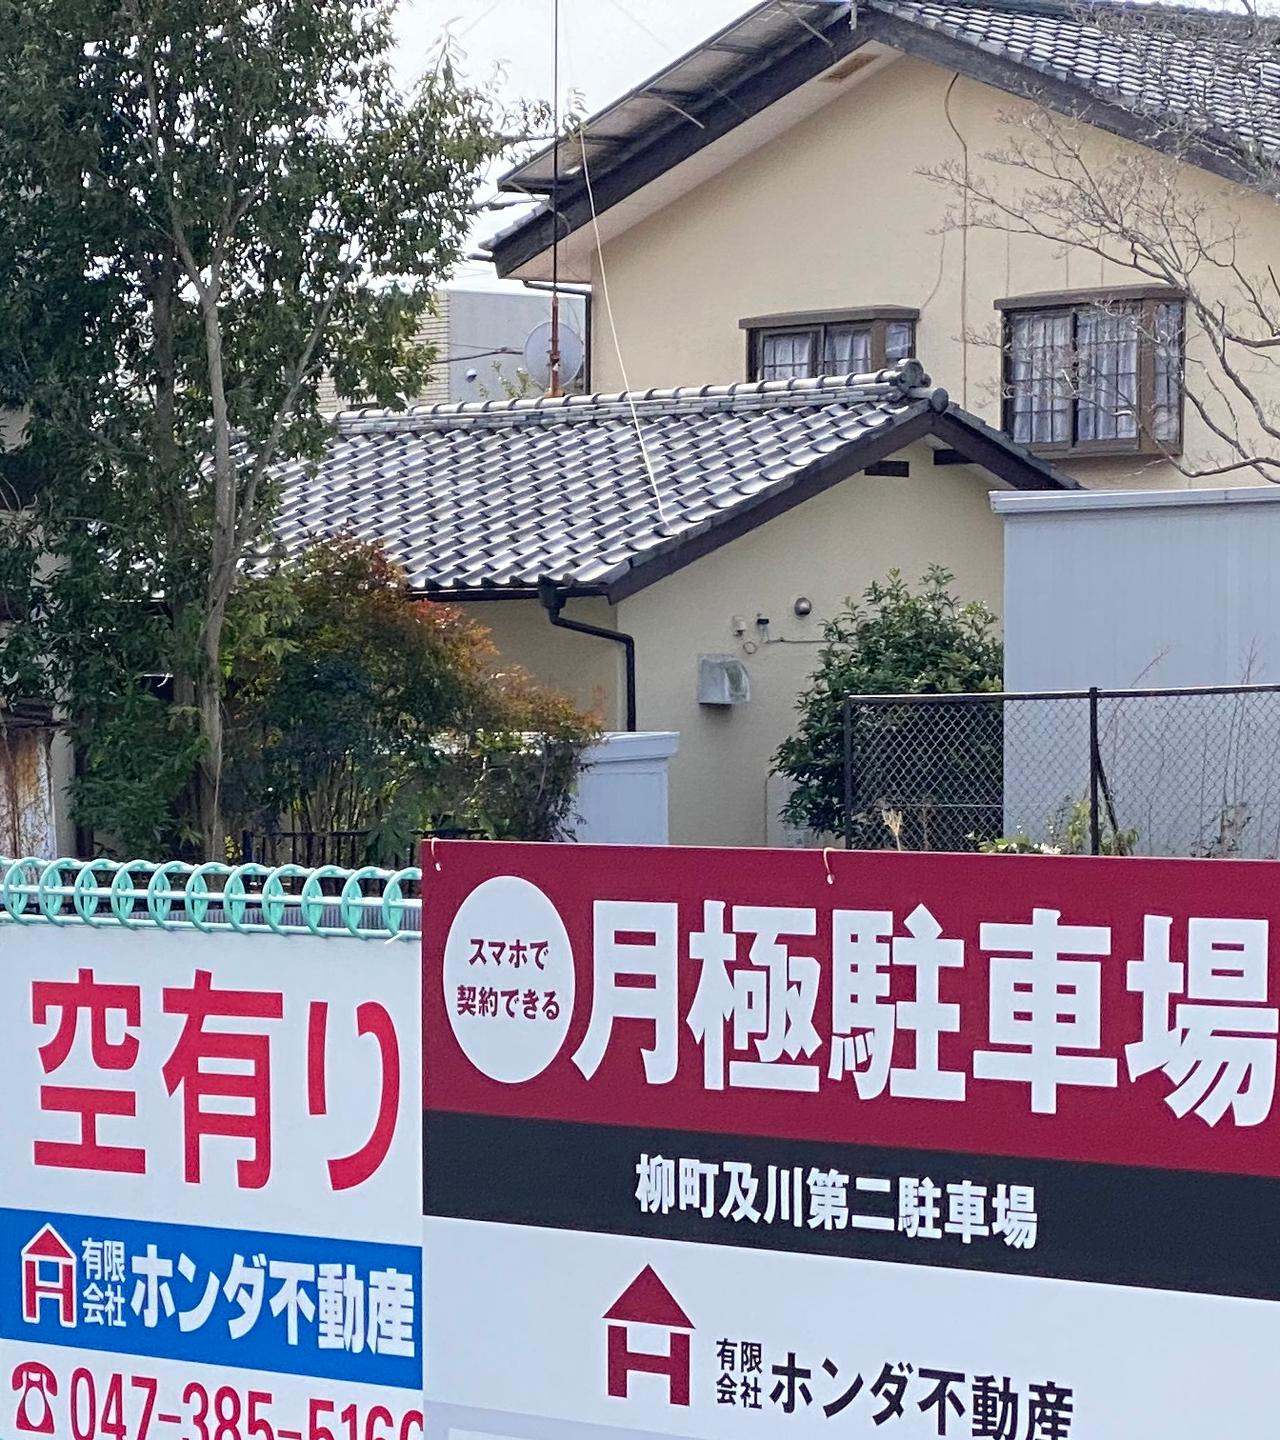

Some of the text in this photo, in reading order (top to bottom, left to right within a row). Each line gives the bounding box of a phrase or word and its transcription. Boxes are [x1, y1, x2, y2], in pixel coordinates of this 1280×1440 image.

[468, 937, 549, 969] スマホで
[457, 985, 561, 1022] 契約できる
[571, 898, 1280, 1127] 月極駐車場
[31, 968, 401, 1191] 空有り
[635, 1152, 1040, 1251] 柳町及川第二駐車場
[81, 1237, 126, 1284] 有限
[81, 1284, 127, 1328] 会社
[130, 1243, 416, 1358] ホンダ不動産
[716, 1338, 763, 1375] 有限
[716, 1375, 764, 1412] 会社
